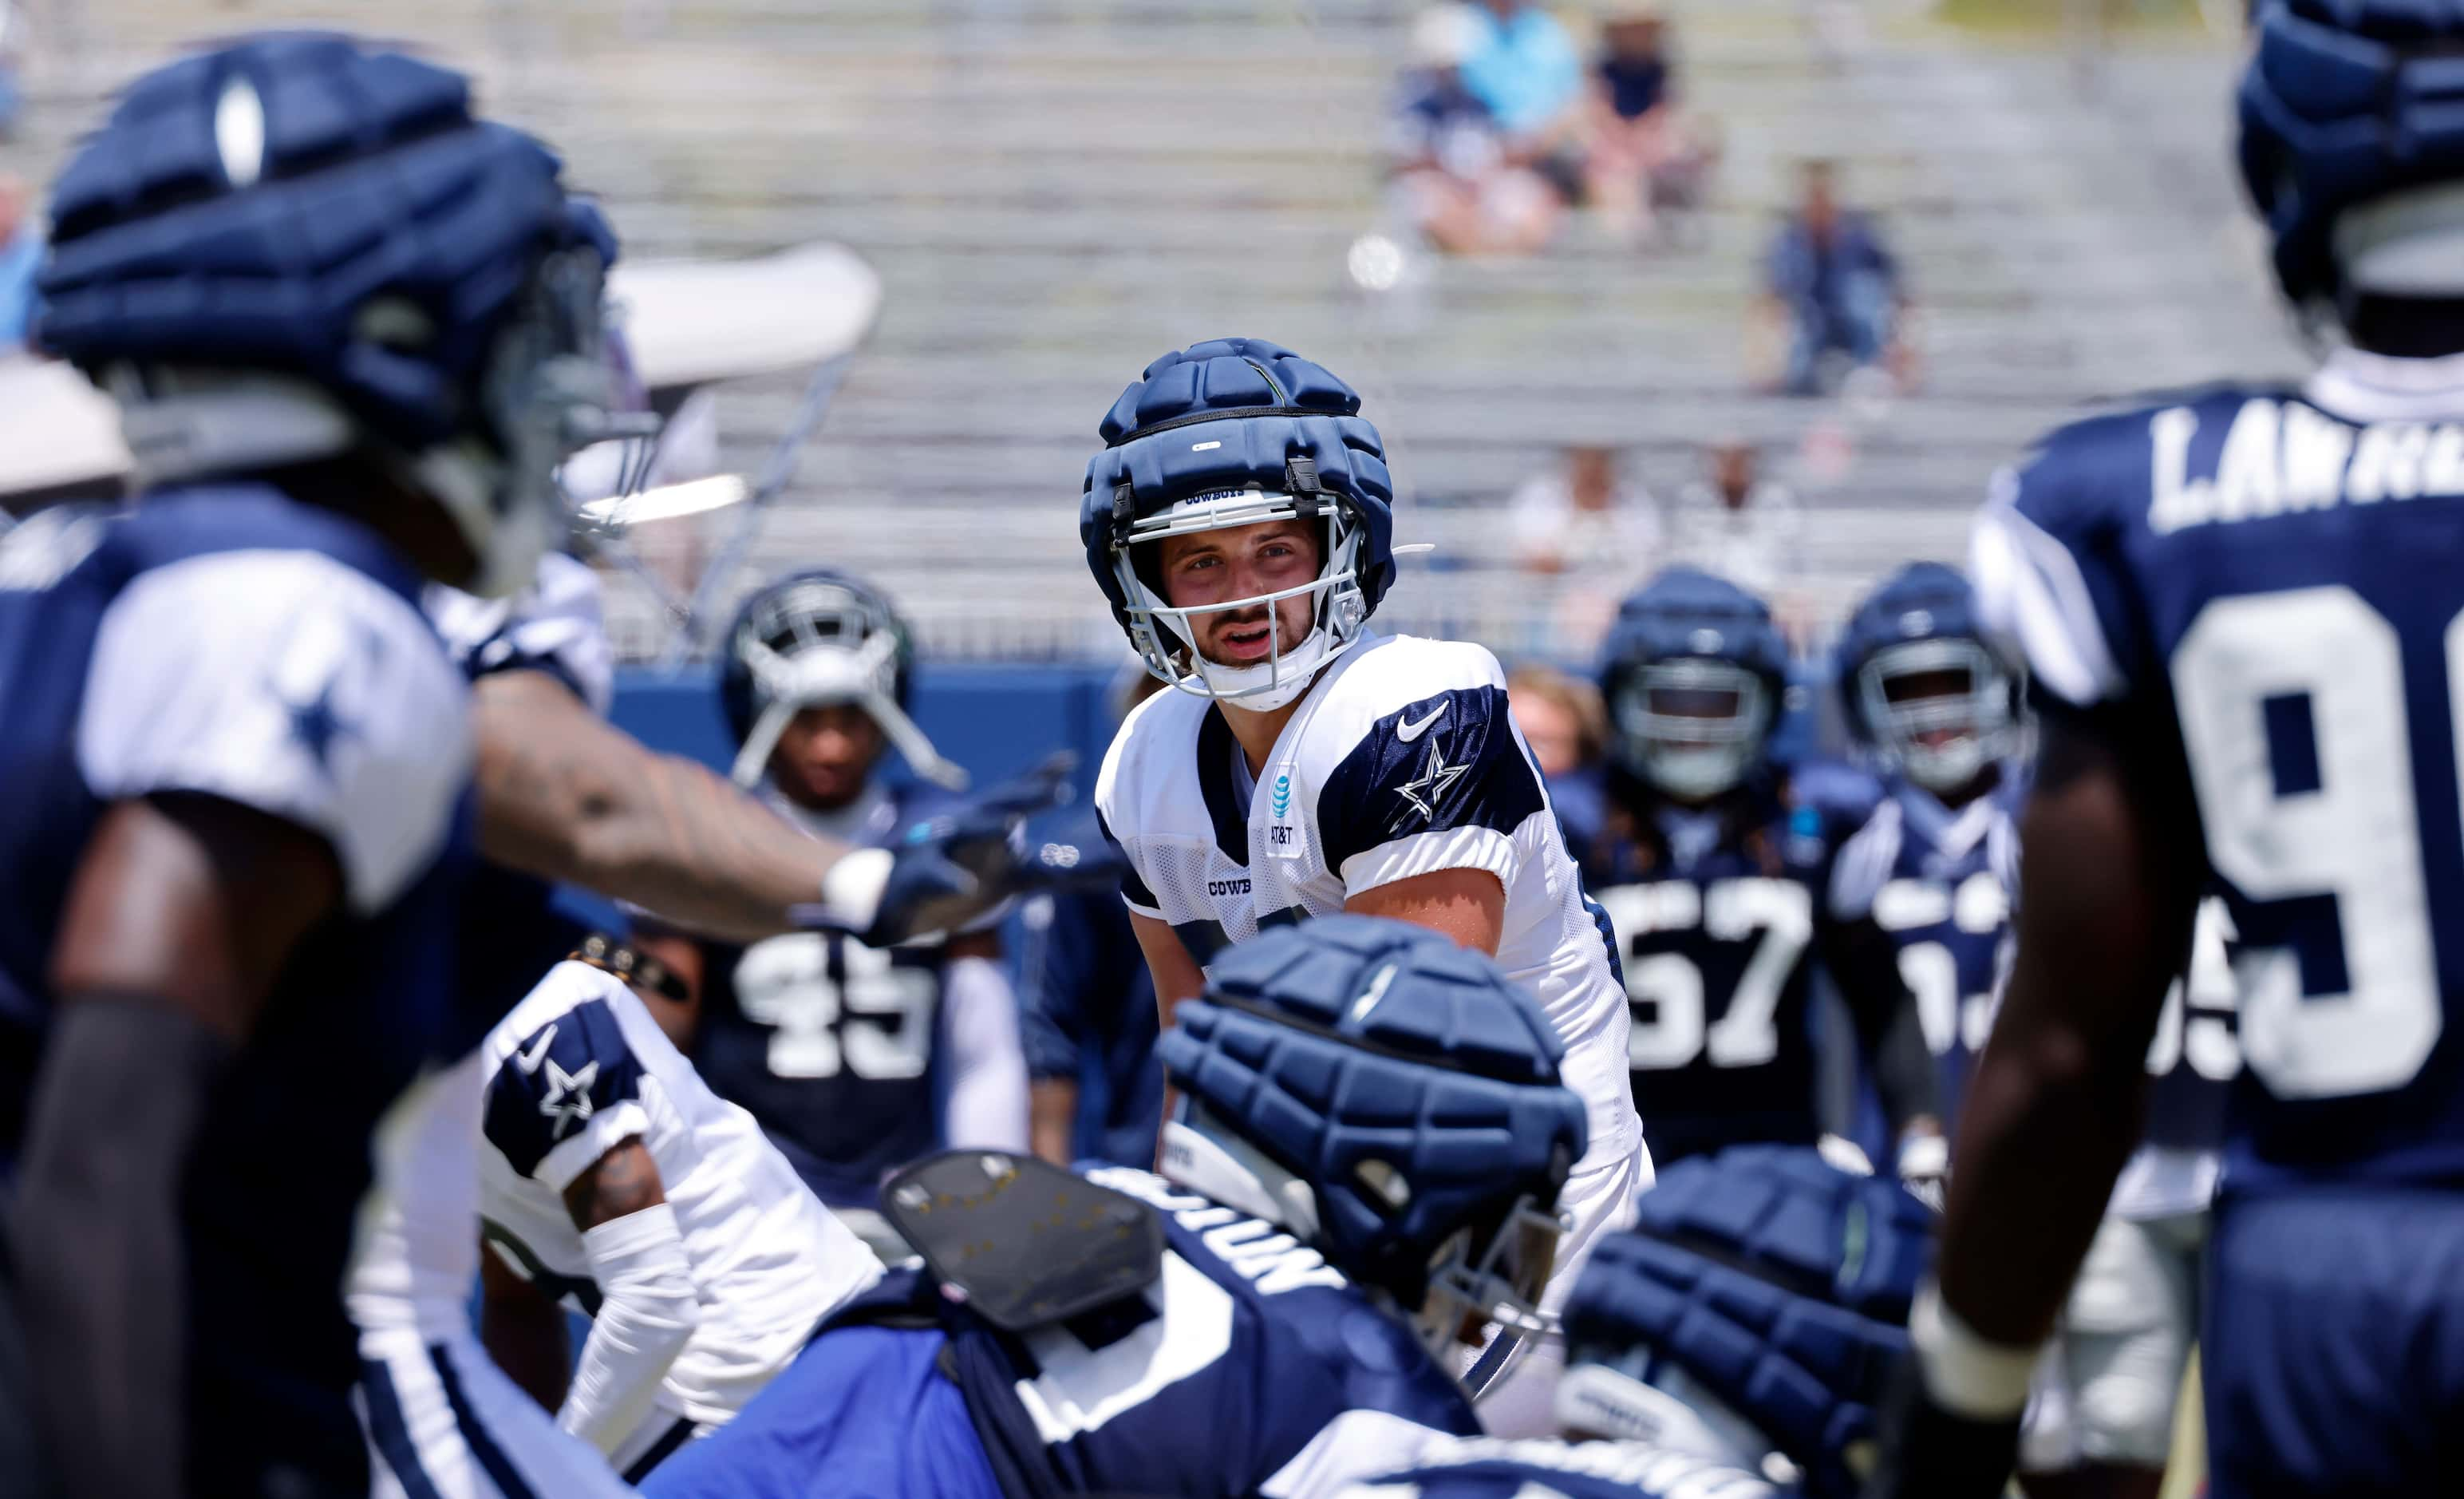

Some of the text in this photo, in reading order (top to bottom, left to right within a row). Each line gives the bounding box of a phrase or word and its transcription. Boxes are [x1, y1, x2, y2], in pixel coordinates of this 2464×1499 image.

[1208, 879, 1251, 896] COWB
[1271, 826, 1293, 844] AT&T
[2169, 583, 2464, 1102] 9
[1598, 876, 1813, 1070] 57
